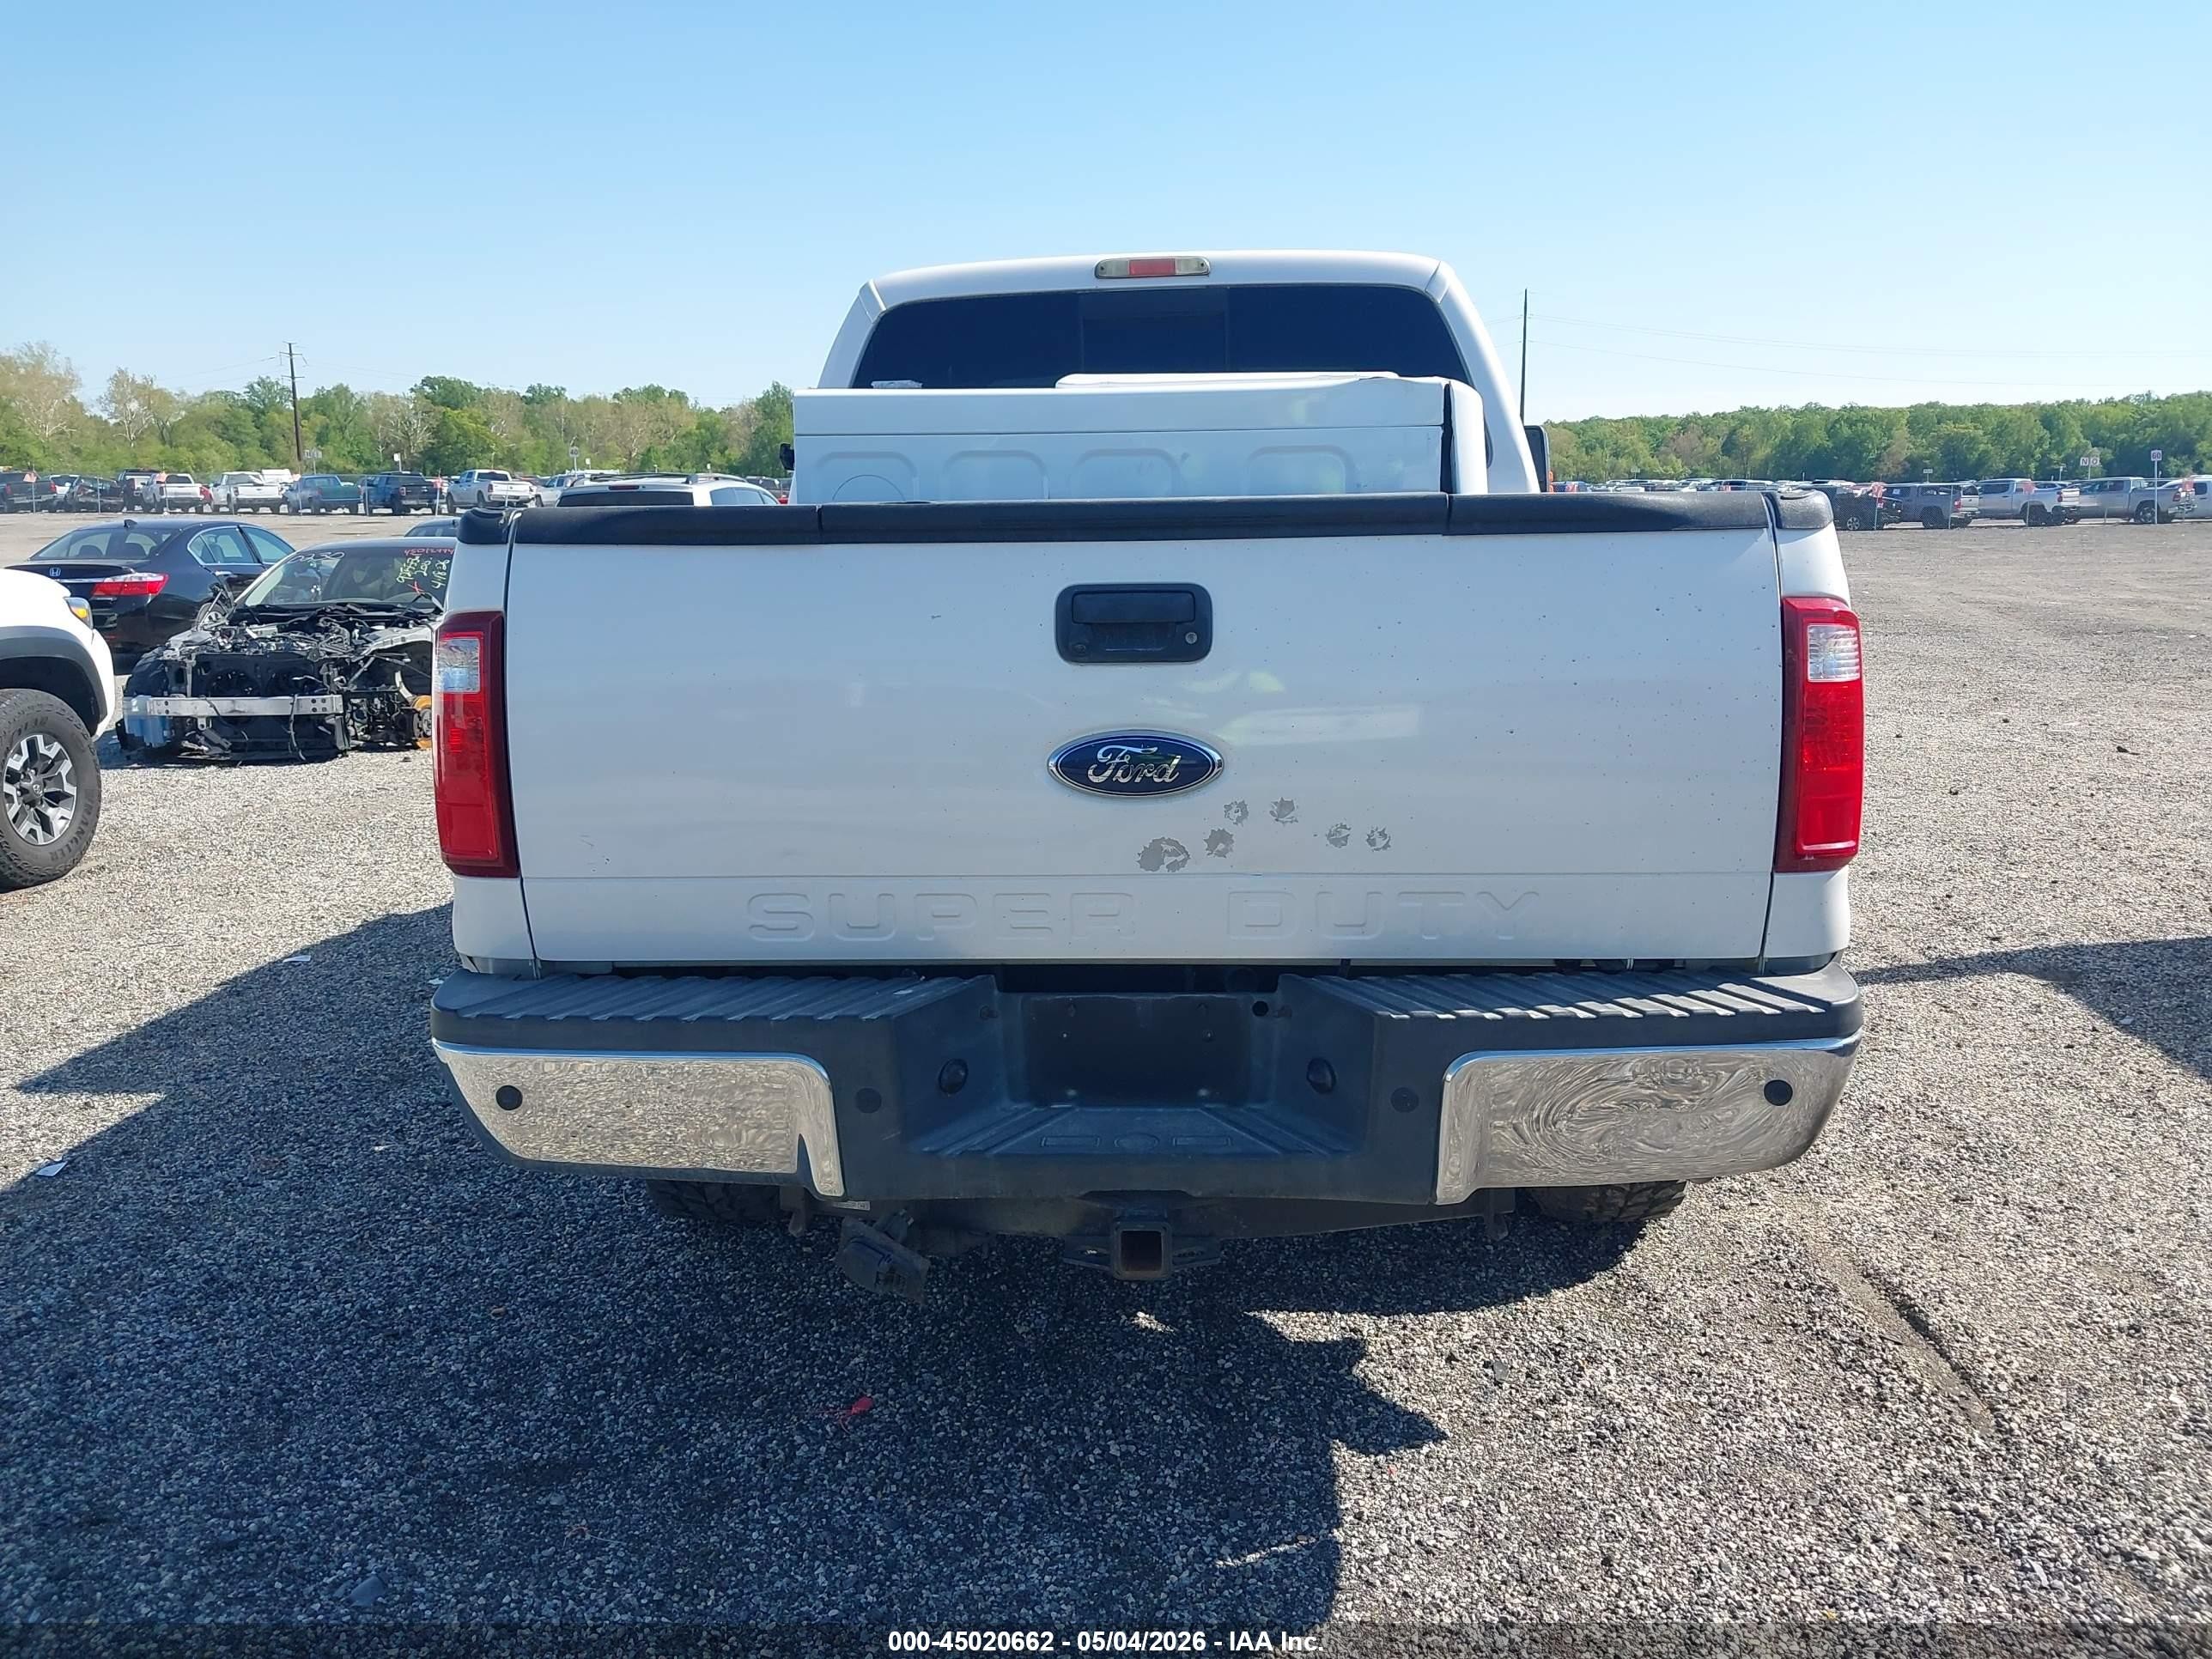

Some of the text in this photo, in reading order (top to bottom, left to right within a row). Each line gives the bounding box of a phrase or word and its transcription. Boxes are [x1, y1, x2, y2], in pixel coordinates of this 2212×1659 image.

[1087, 744, 1182, 783] Ford
[747, 890, 1540, 941] SUPER DUTY
